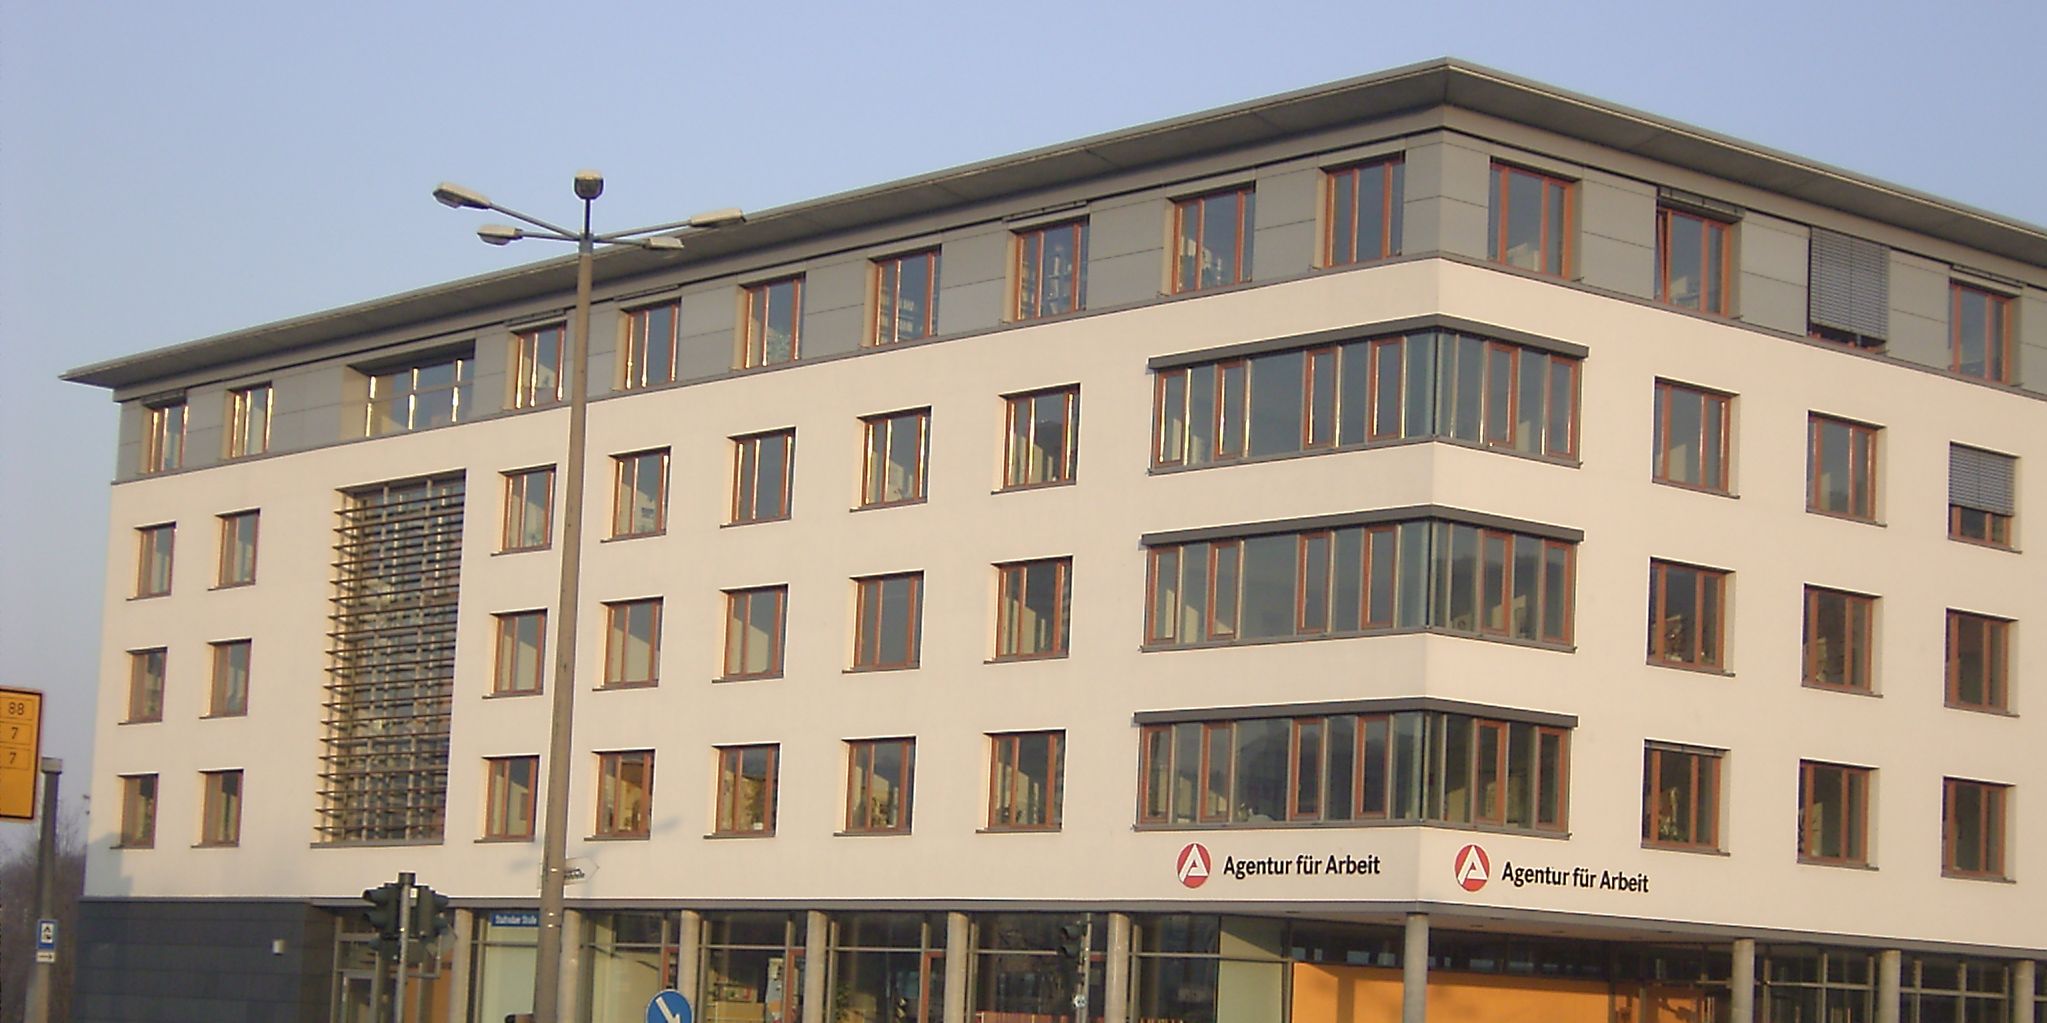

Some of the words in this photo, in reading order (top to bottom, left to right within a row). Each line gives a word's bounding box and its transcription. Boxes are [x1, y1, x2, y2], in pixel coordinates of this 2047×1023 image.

[9, 702, 24, 715] 88
[11, 727, 18, 739] 7
[10, 752, 16, 764] 7
[1223, 855, 1292, 880] Agentur
[1296, 854, 1322, 875] für
[1325, 854, 1381, 875] Arbeit
[1501, 861, 1570, 888] Agentur
[1573, 867, 1597, 888] für
[1599, 871, 1650, 893] Arbeit
